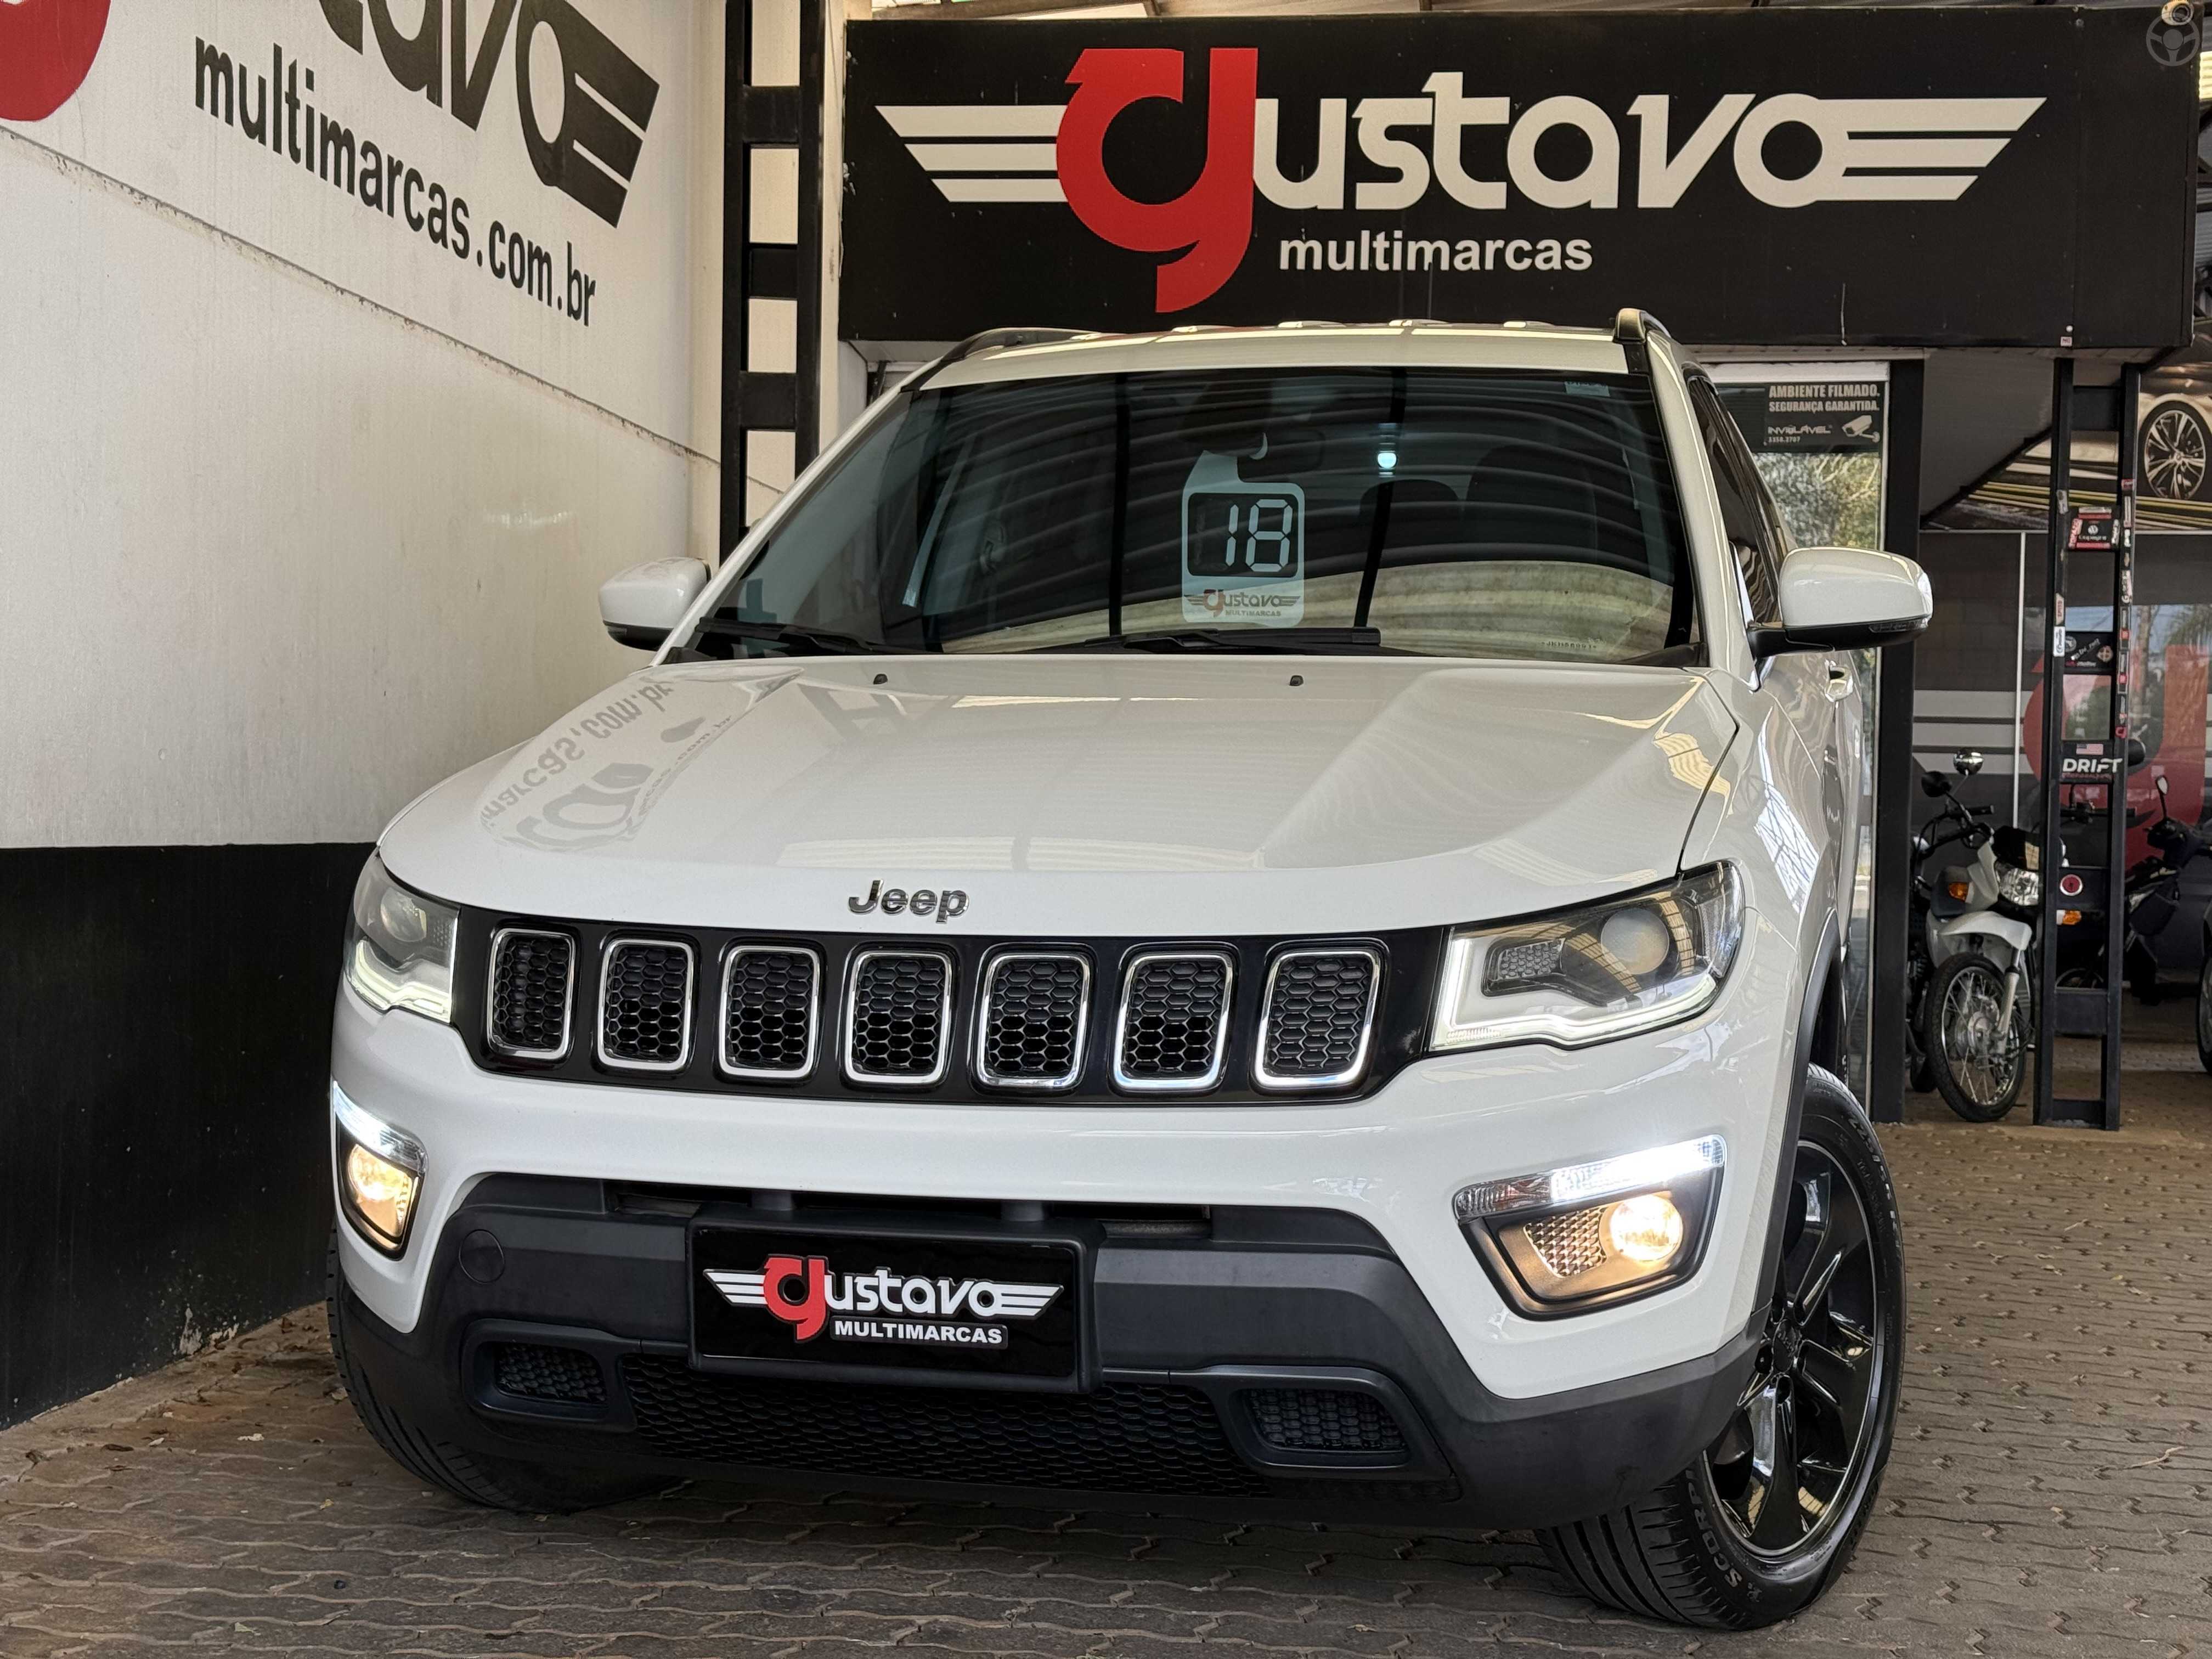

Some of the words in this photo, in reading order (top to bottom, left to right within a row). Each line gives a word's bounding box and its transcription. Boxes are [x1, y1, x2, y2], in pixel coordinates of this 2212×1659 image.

[195, 37, 597, 326] multimarcas.com.br
[1056, 47, 1850, 313] gustavo
[1280, 229, 1593, 272] multimarcas
[1769, 385, 1826, 398] AMBIENTE
[1828, 385, 1881, 397] FILMADO.
[1769, 401, 1824, 414] SEGURANÇA
[1825, 400, 1880, 411] GARANTIDA.
[1226, 499, 1293, 572] 18
[1203, 589, 1282, 618] gustavo
[2062, 758, 2123, 773] DRIFT
[848, 879, 969, 924] Jeep
[763, 1255, 1003, 1341] gustavo
[834, 1320, 1003, 1344] MULTIMARCAS
